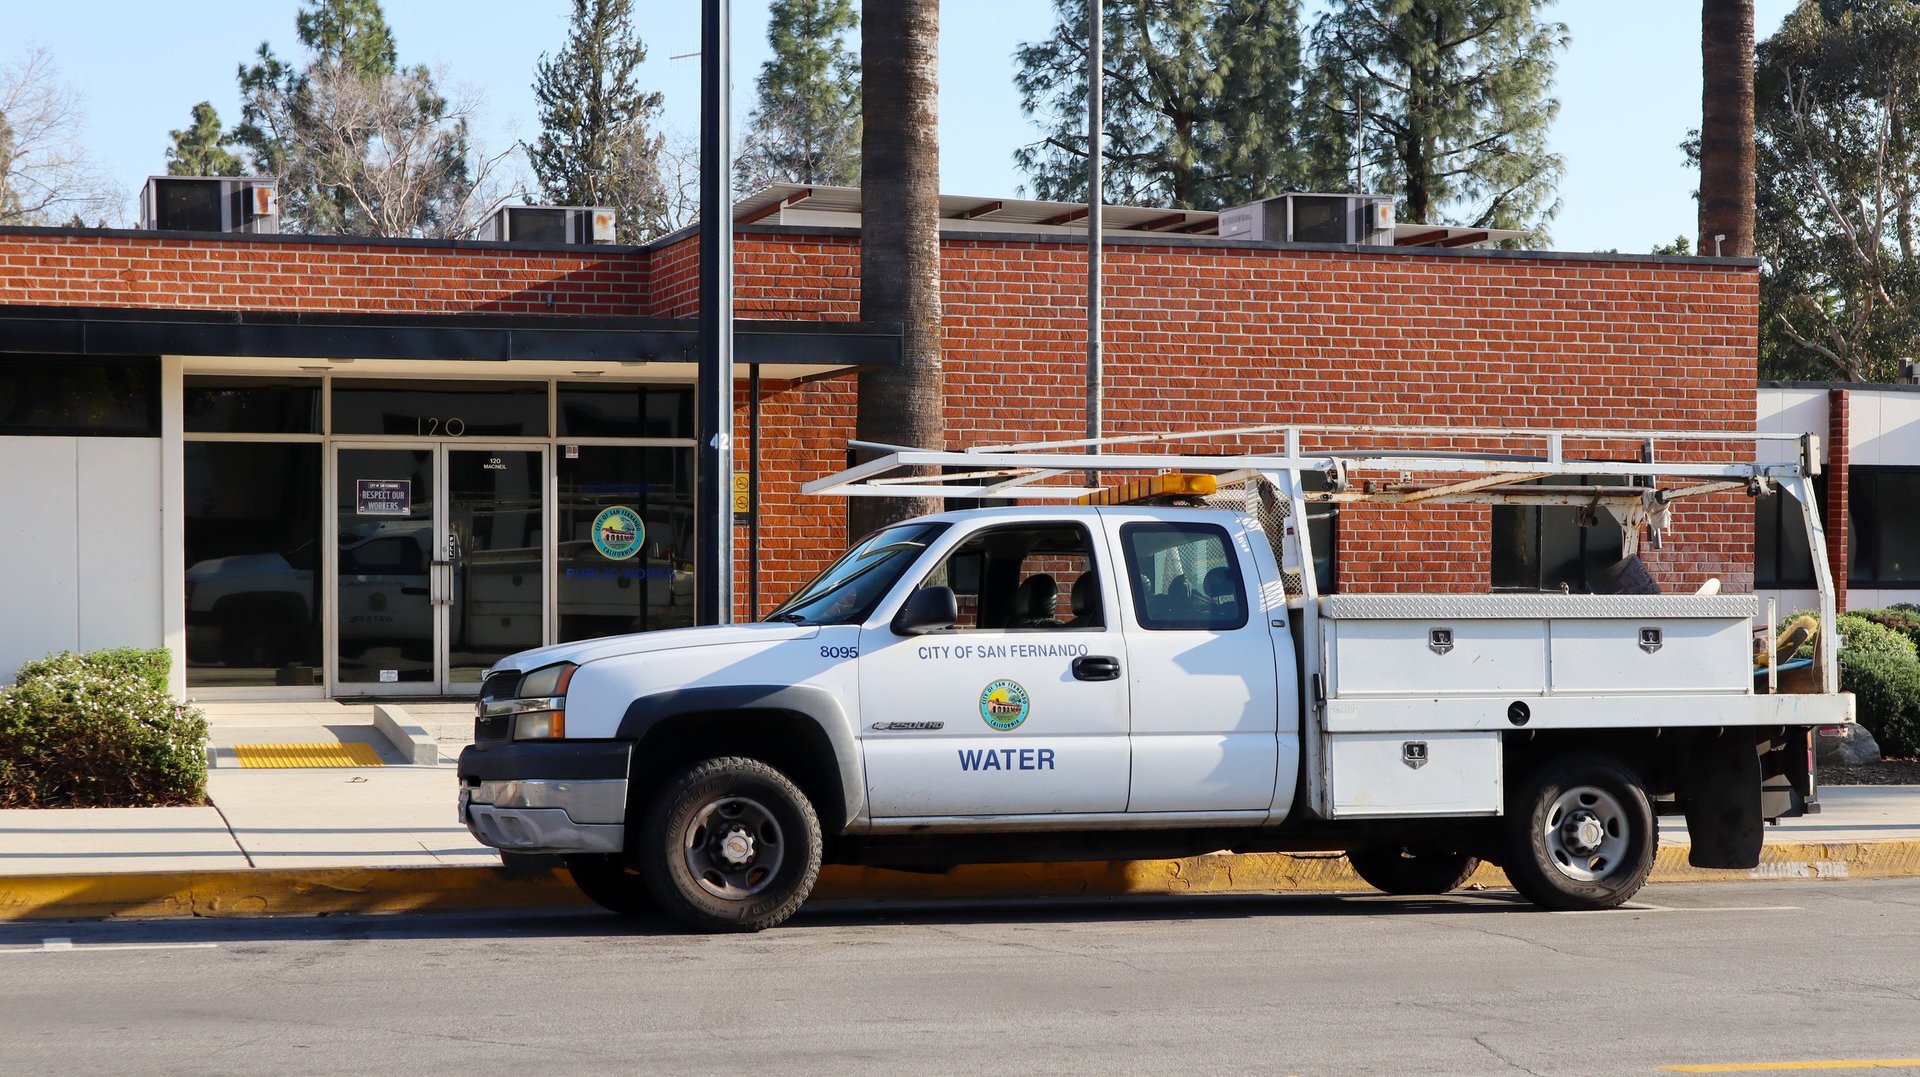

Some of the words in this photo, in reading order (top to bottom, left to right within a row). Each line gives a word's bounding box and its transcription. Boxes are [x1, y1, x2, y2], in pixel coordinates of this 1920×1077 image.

[417, 417, 464, 437] 120
[362, 490, 391, 500] RESPECT
[391, 491, 405, 500] OUR
[367, 501, 399, 511] WORKERS
[820, 645, 859, 659] 8095
[918, 645, 950, 659] CITY
[954, 645, 973, 659] OF
[977, 645, 1006, 659] SAN
[1011, 643, 1088, 658] FERNANDO
[990, 719, 1020, 729] CALIFORNIA
[958, 748, 1055, 771] WATER
